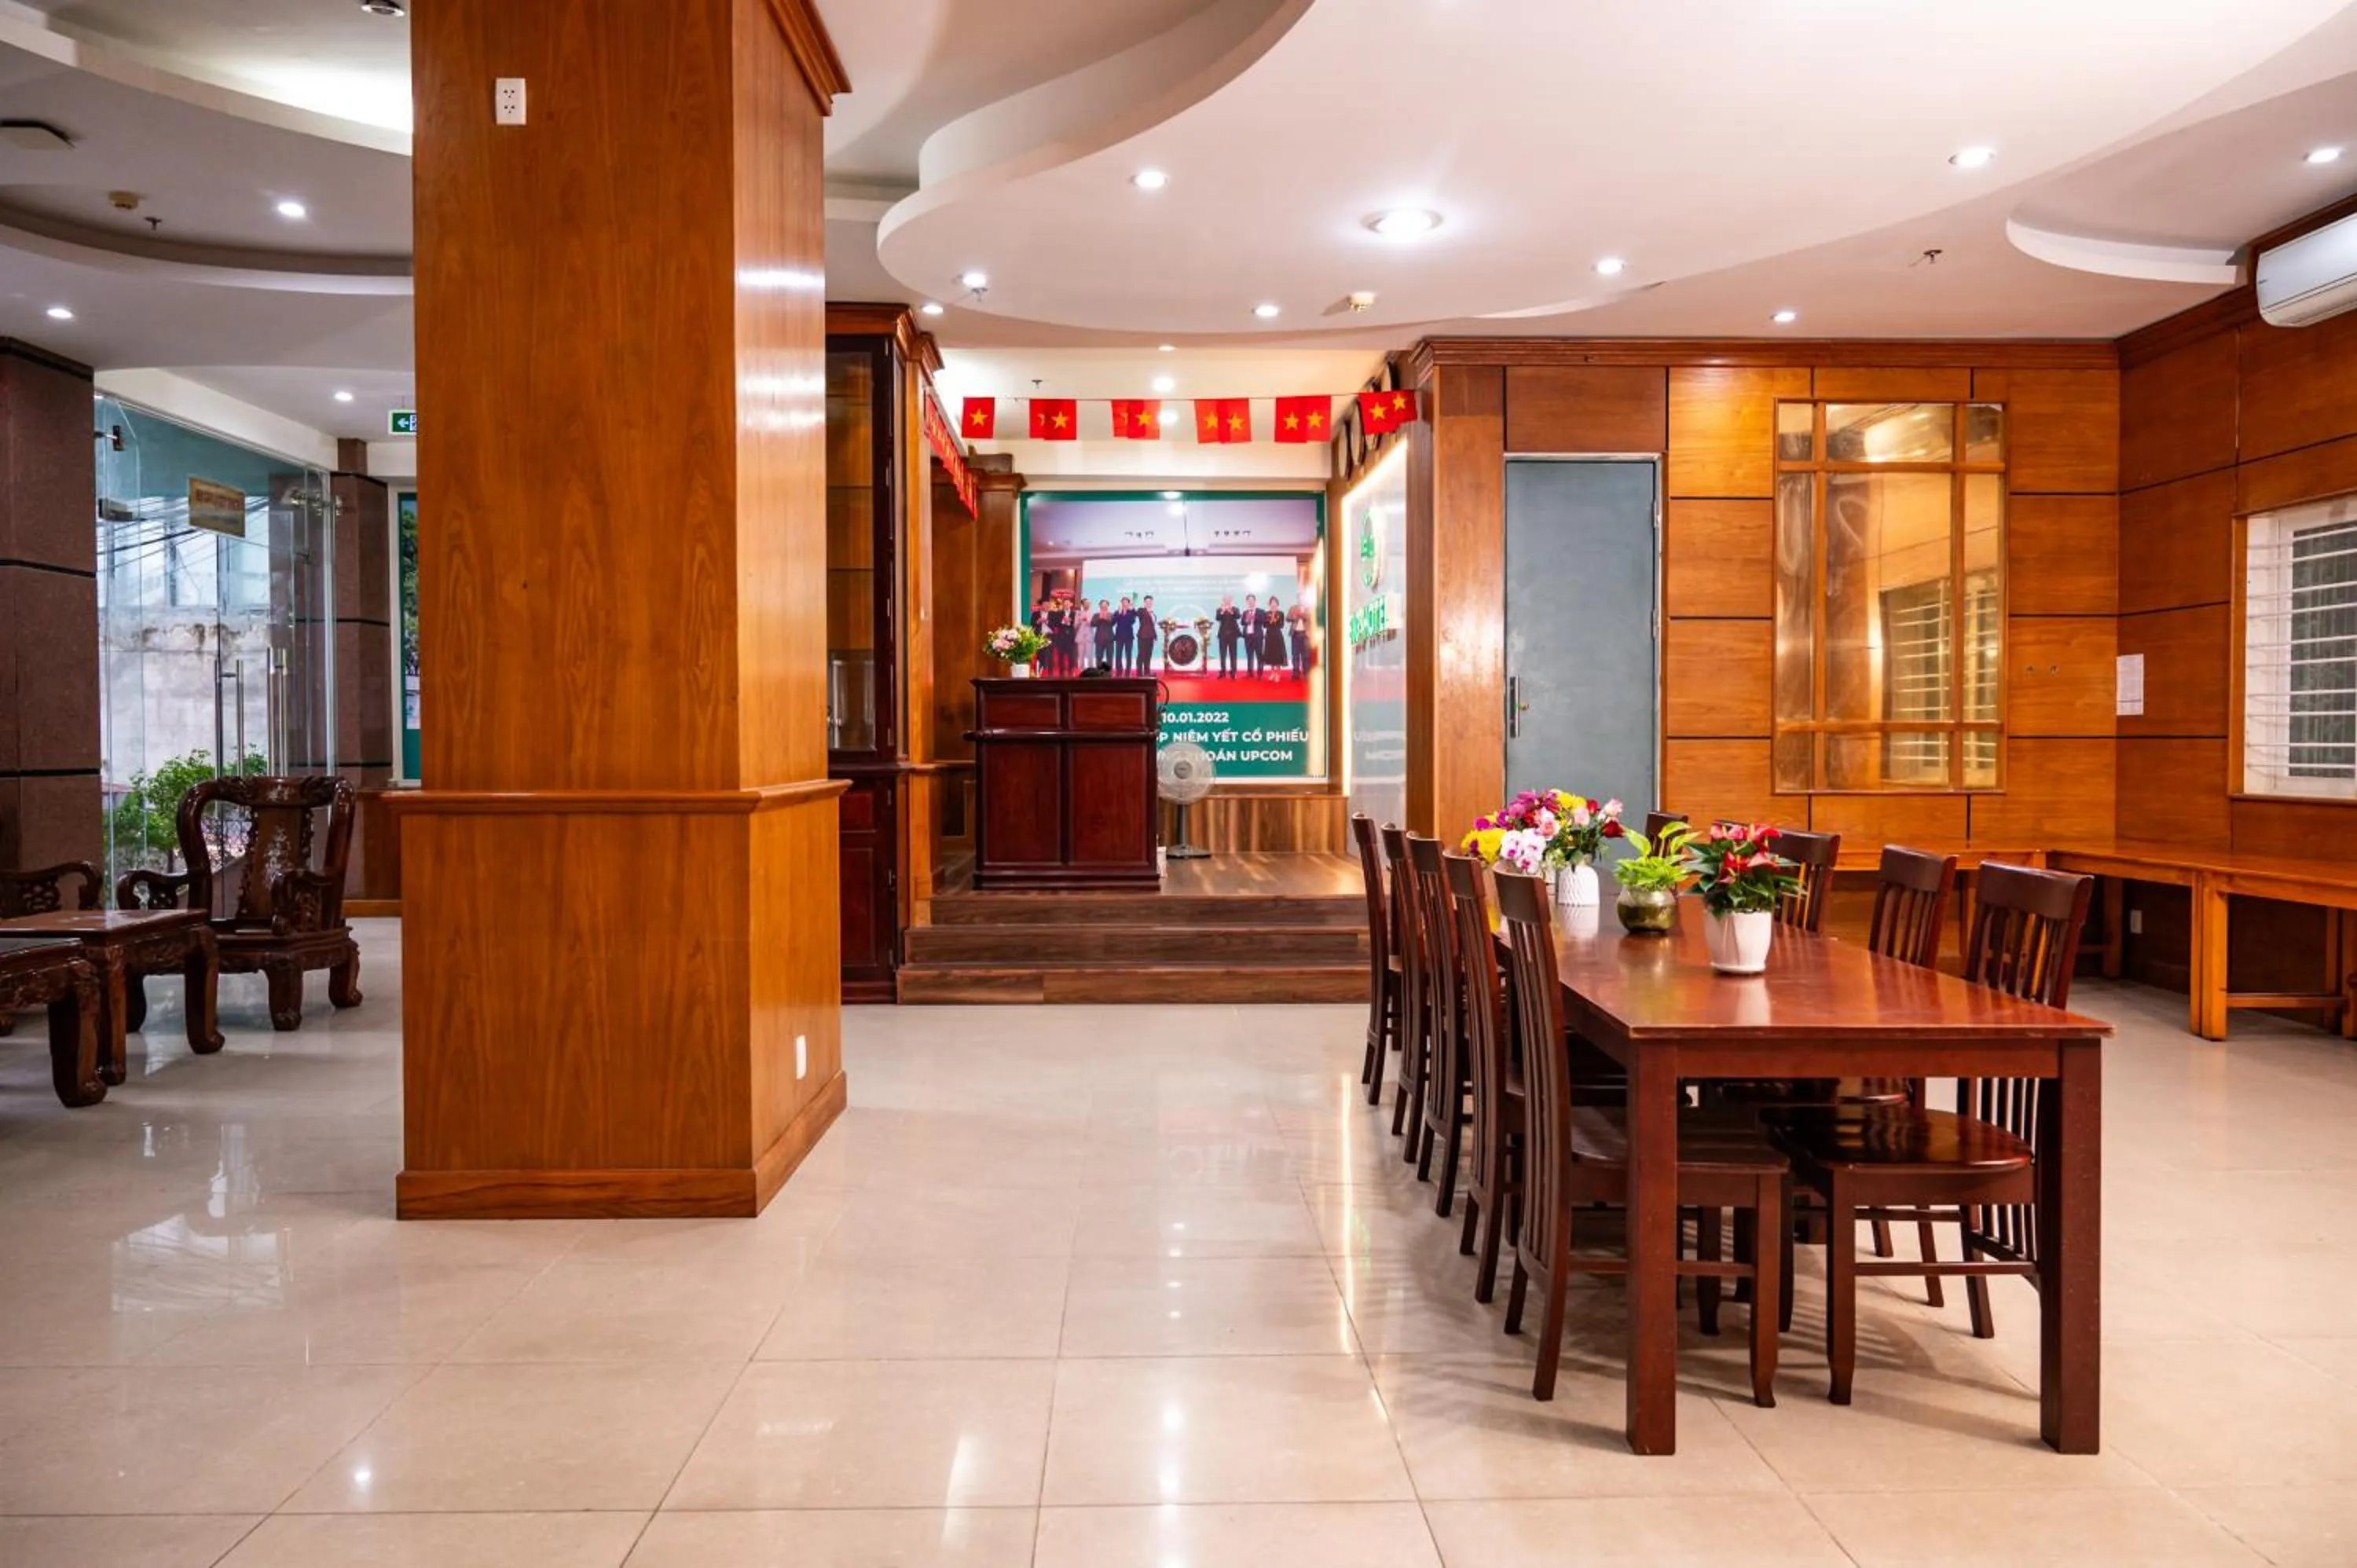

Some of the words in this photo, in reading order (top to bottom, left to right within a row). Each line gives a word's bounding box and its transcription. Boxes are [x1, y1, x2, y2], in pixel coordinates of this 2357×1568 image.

[1161, 712, 1230, 723] 10.01.2022
[1173, 728, 1209, 742] NIÊM
[1211, 727, 1239, 742] YẾT
[1266, 727, 1308, 742] PHIẾU
[1240, 749, 1292, 761] UPCOM
